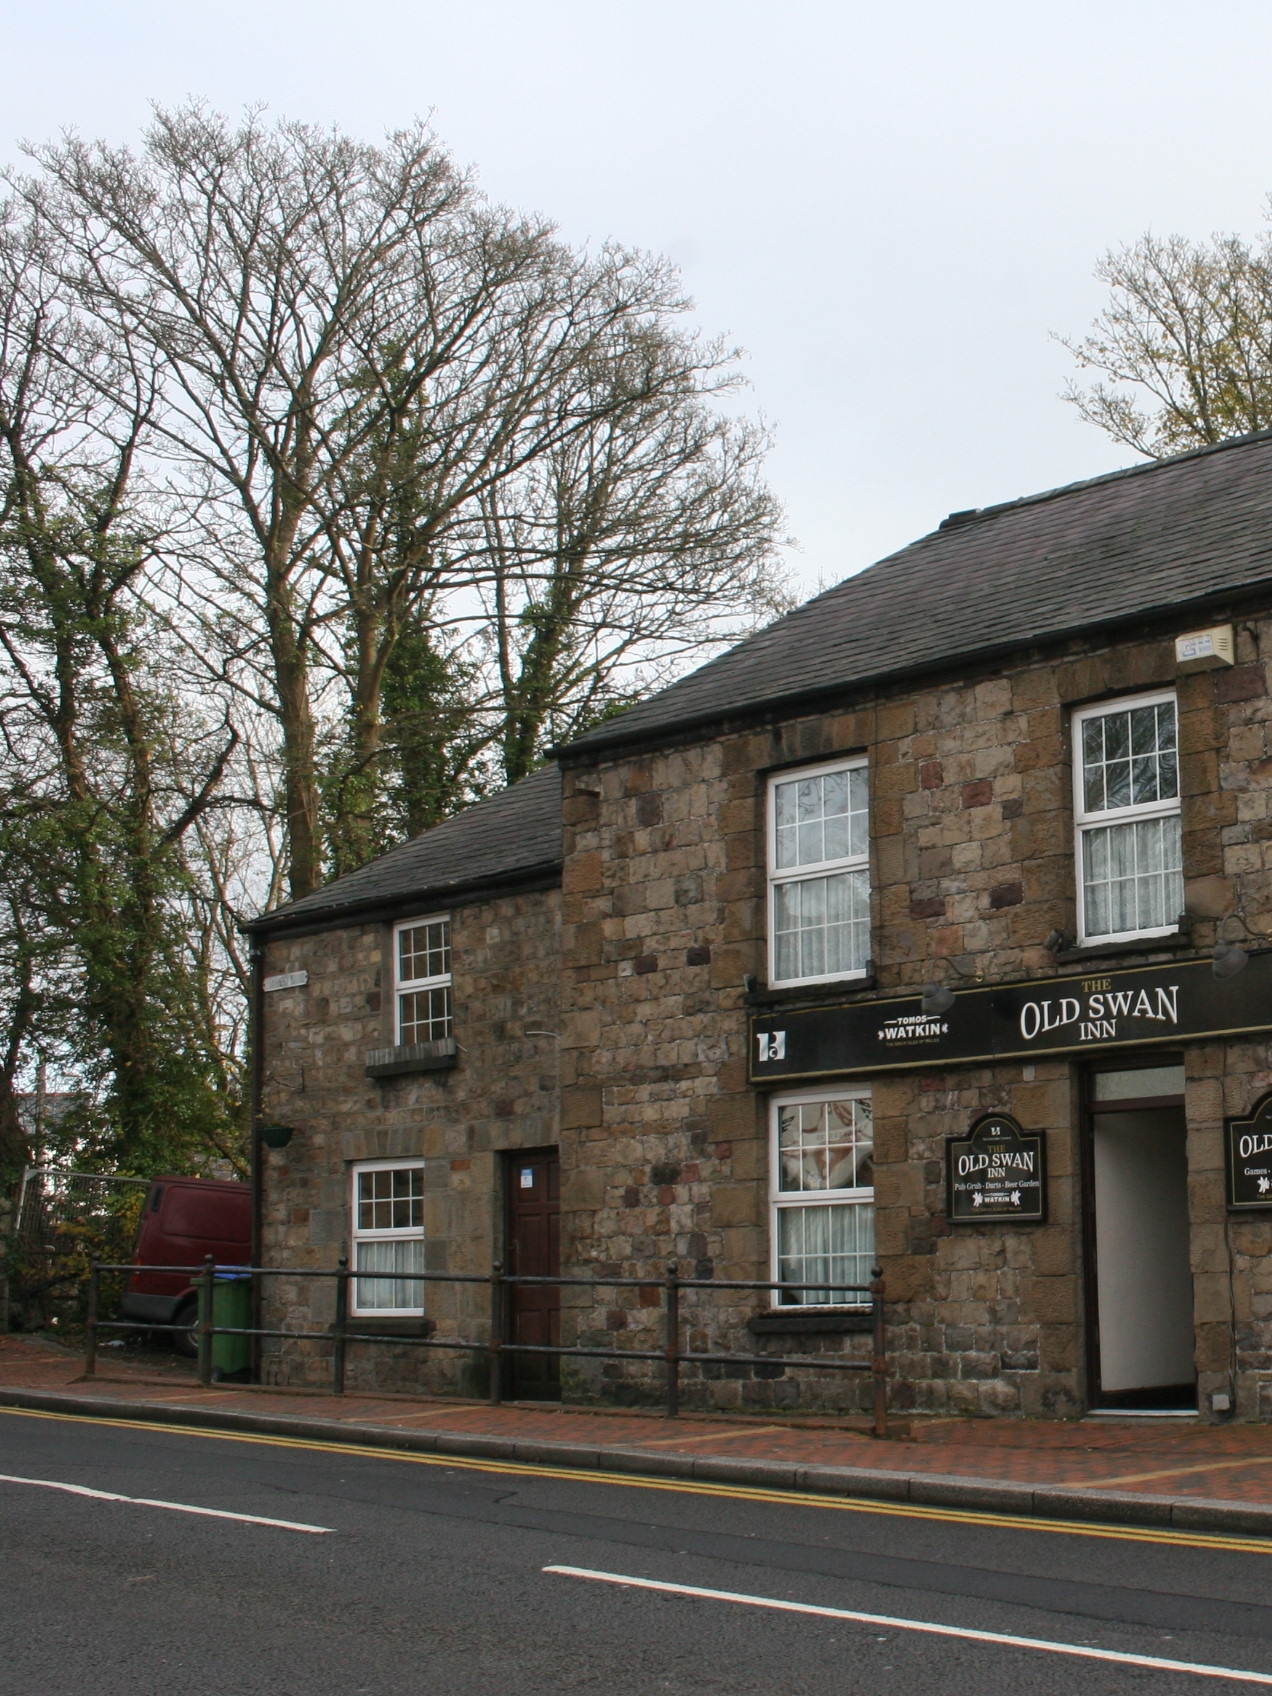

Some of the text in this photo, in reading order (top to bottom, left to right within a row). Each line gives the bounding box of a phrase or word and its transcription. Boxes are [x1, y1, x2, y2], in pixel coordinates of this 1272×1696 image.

[1082, 979, 1111, 993] THE
[1020, 985, 1179, 1040] OLD SWAN
[897, 1015, 927, 1025] TOMOS
[885, 1023, 940, 1039] WATKIN
[1079, 1018, 1117, 1041] INN
[987, 1145, 1006, 1153] THE
[958, 1152, 1034, 1176] OLD SWAN
[987, 1167, 1006, 1178] INN
[1244, 1167, 1268, 1175] Games
[954, 1183, 966, 1191] Pub
[966, 1182, 982, 1190] Grub
[985, 1181, 1001, 1189] Darts
[1005, 1180, 1018, 1188] Beer
